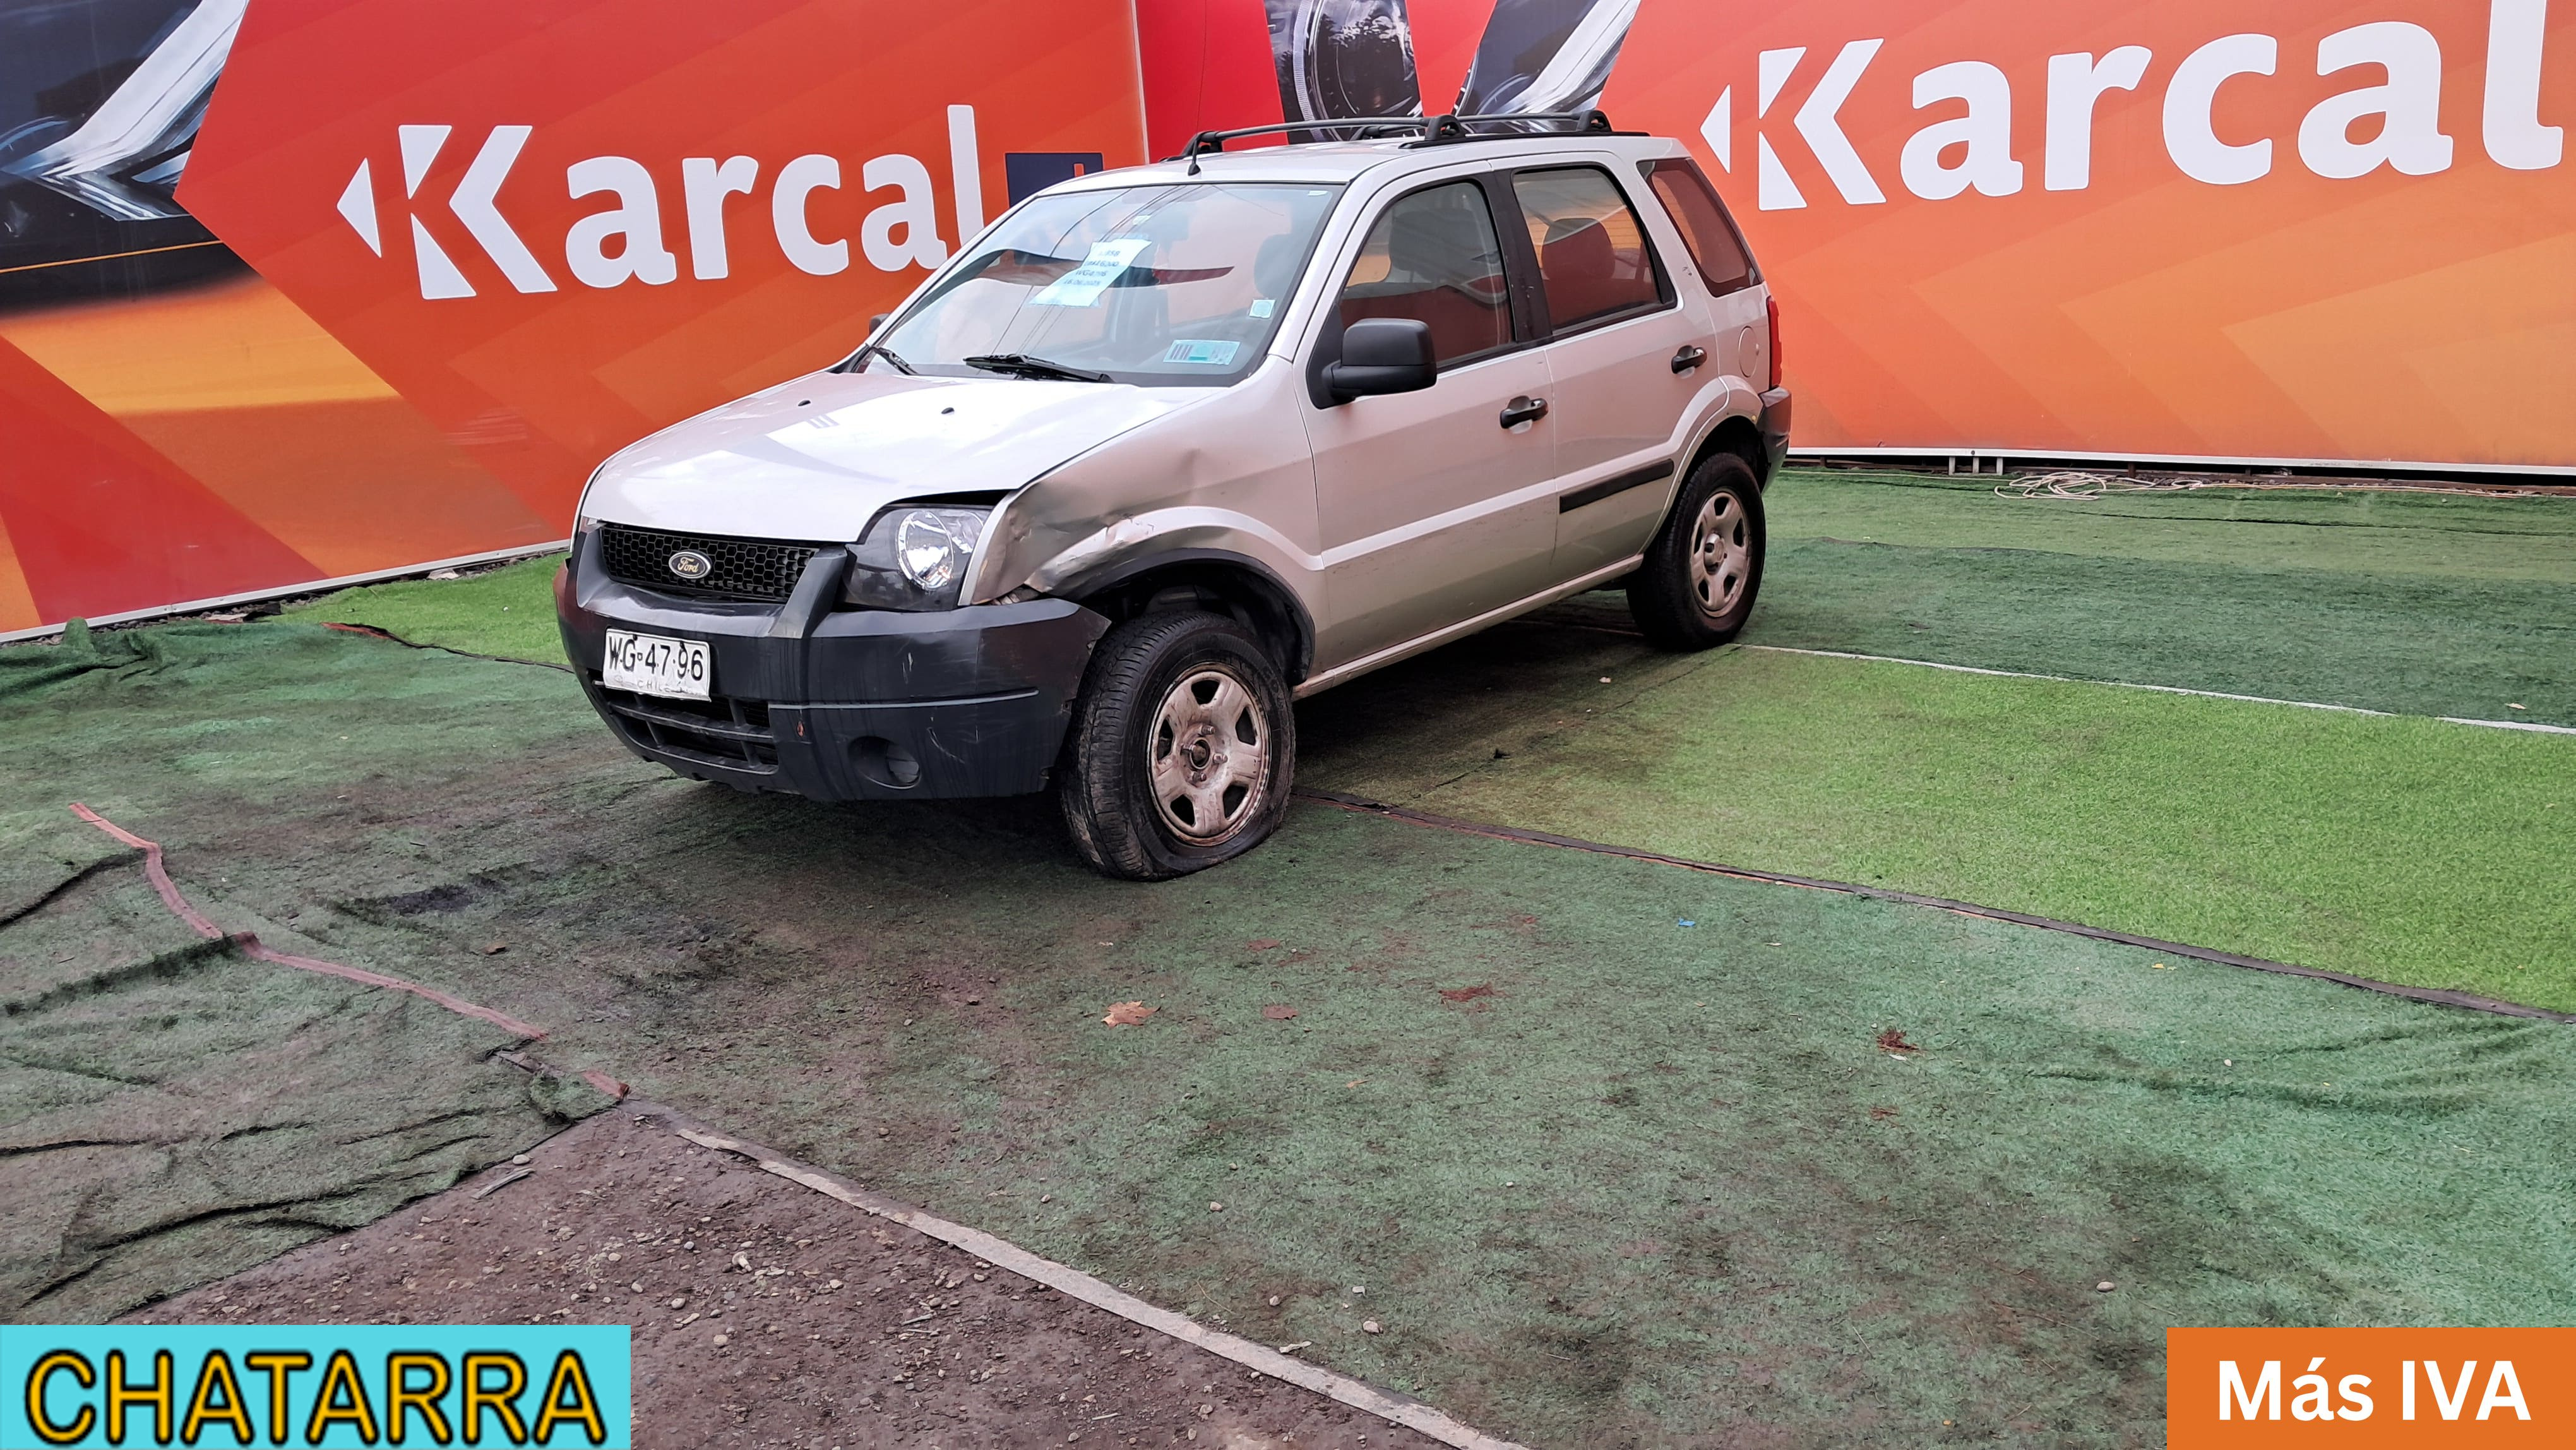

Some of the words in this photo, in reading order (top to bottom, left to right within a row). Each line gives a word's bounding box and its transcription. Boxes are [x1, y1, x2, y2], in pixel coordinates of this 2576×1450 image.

[398, 104, 987, 299] Karcal
[1758, 0, 2564, 211] Karcal
[677, 556, 700, 573] Ford
